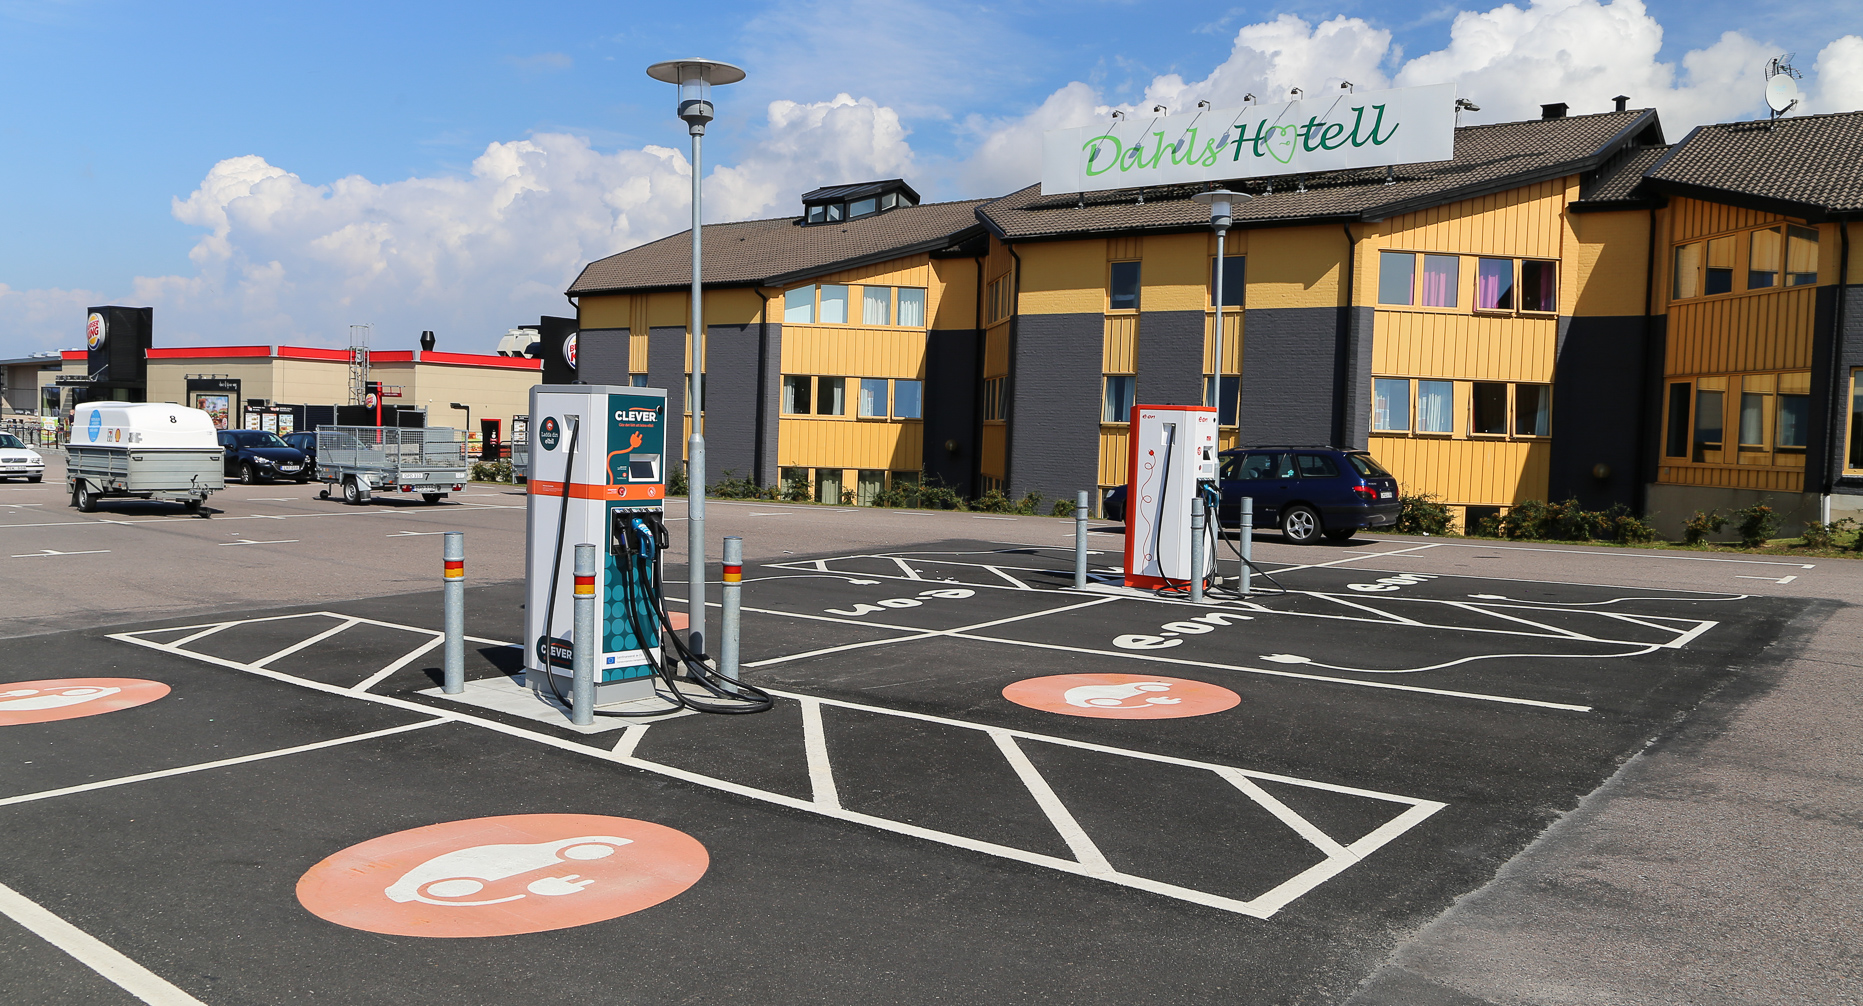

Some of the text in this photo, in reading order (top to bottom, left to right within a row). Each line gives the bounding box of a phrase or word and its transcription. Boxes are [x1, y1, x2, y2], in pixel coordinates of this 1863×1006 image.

[1082, 104, 1400, 176] Dahls Hotell
[169, 415, 177, 424] 8
[424, 472, 430, 481] 7
[541, 644, 572, 660] CEVER
